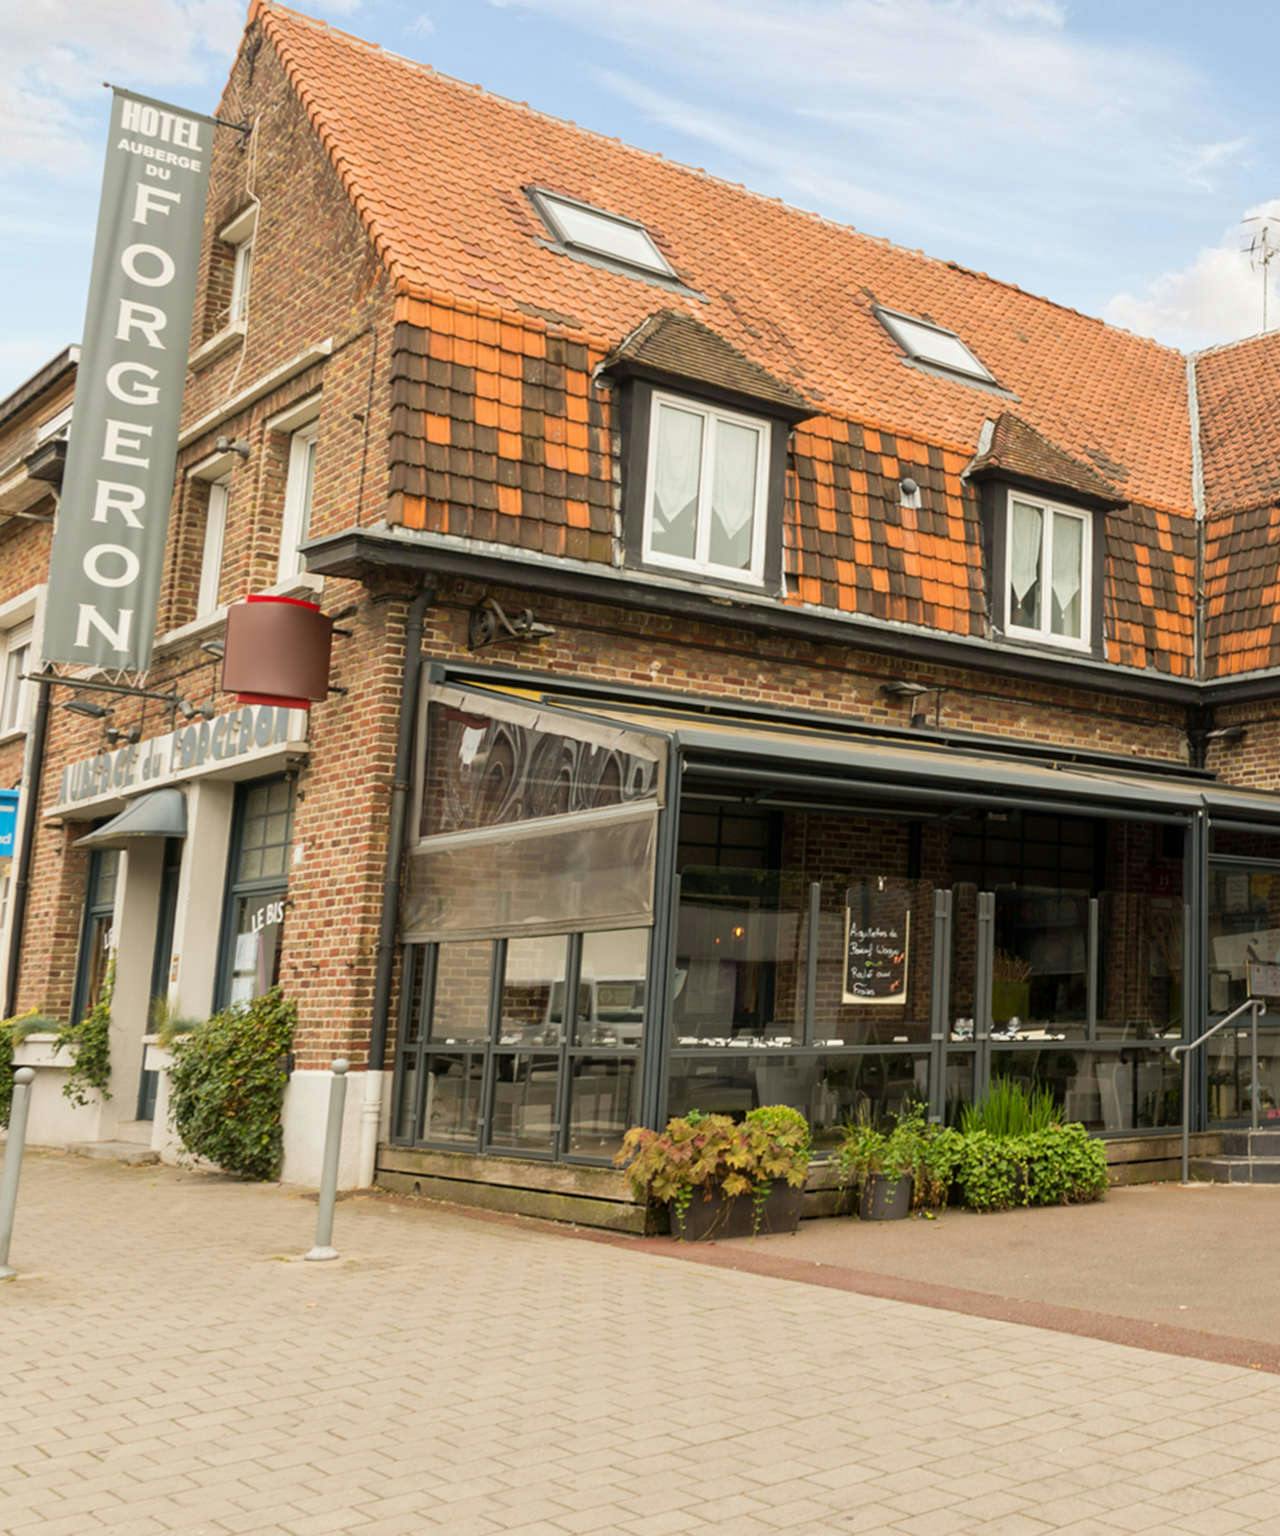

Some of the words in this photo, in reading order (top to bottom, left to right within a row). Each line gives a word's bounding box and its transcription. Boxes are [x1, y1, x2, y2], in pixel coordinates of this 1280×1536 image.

[121, 99, 203, 152] HOTEL
[117, 138, 202, 173] AUBERGE
[145, 163, 171, 181] DU
[73, 182, 181, 653] FORGERON
[58, 744, 136, 805] AUBERGE
[141, 737, 162, 781] du
[169, 705, 290, 774] FORGERON
[251, 907, 265, 934] LE
